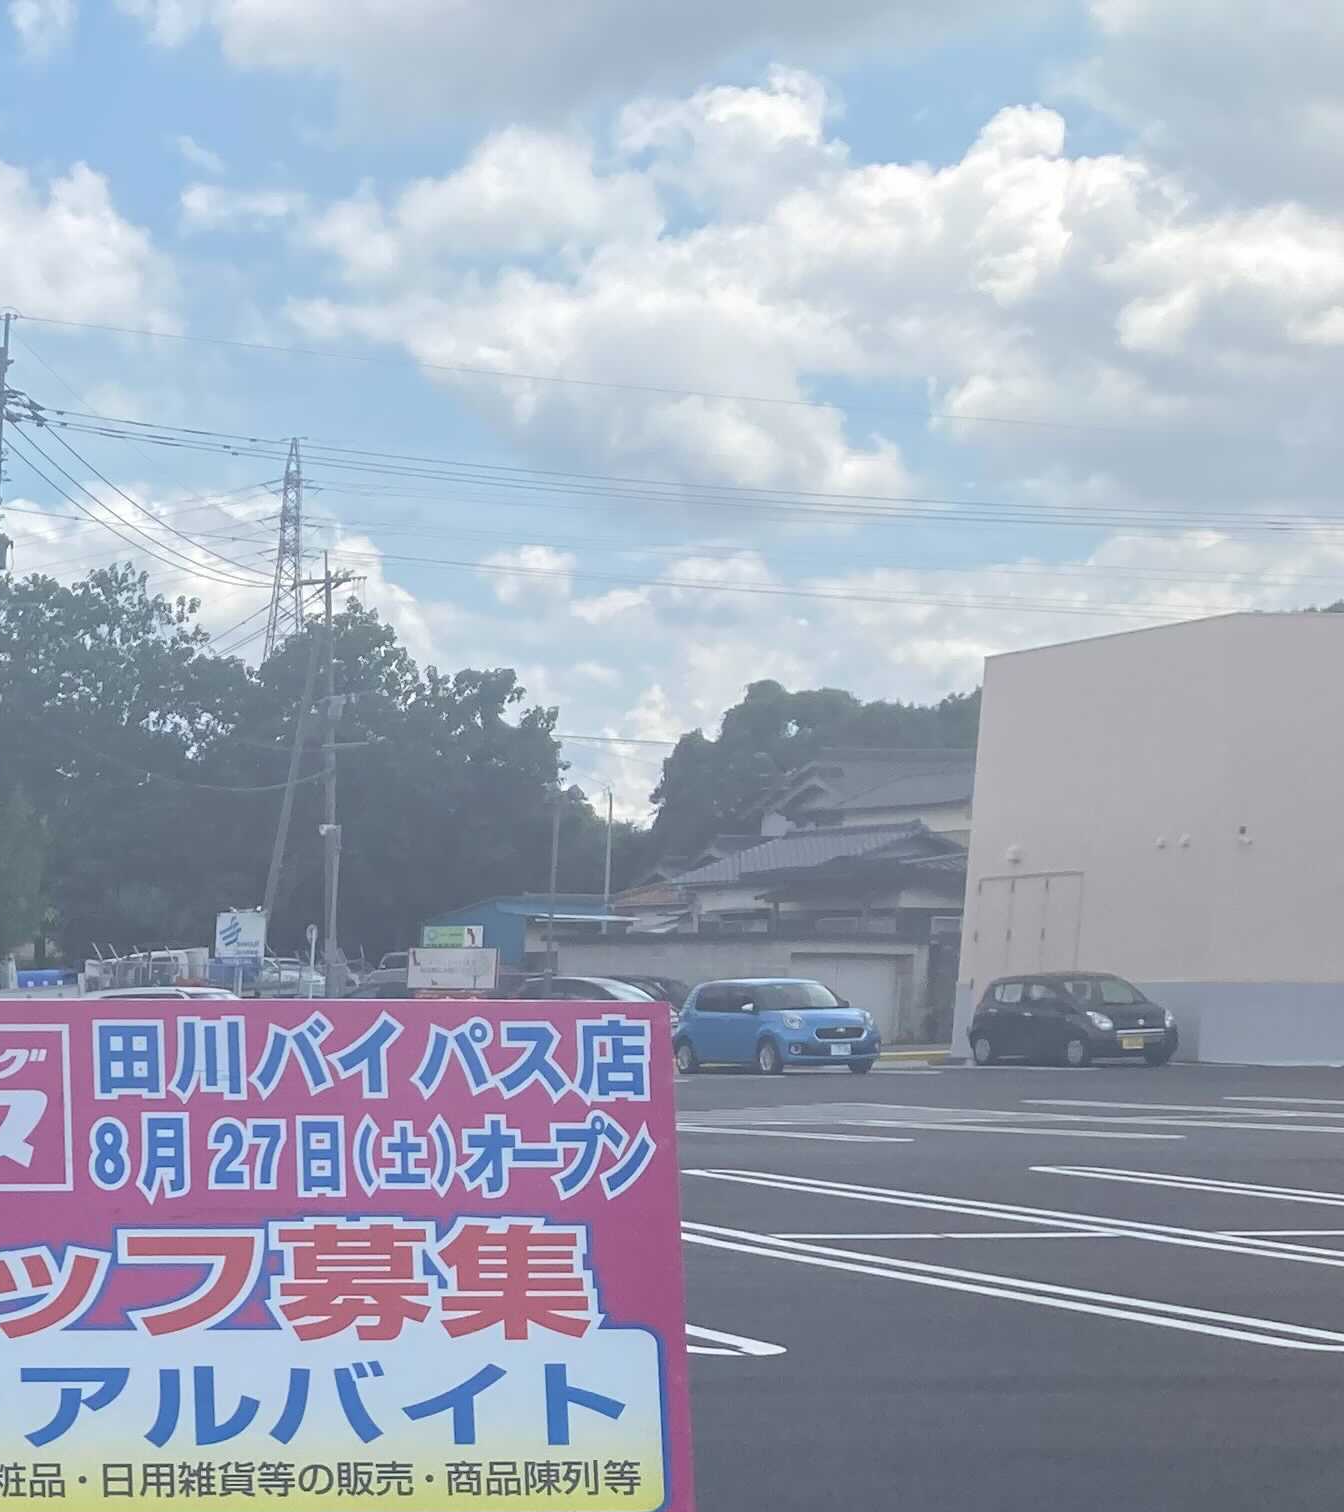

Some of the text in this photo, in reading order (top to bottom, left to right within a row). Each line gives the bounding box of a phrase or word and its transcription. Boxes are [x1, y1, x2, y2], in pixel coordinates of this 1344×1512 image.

[93, 1011, 651, 1102] 田川バイパス店
